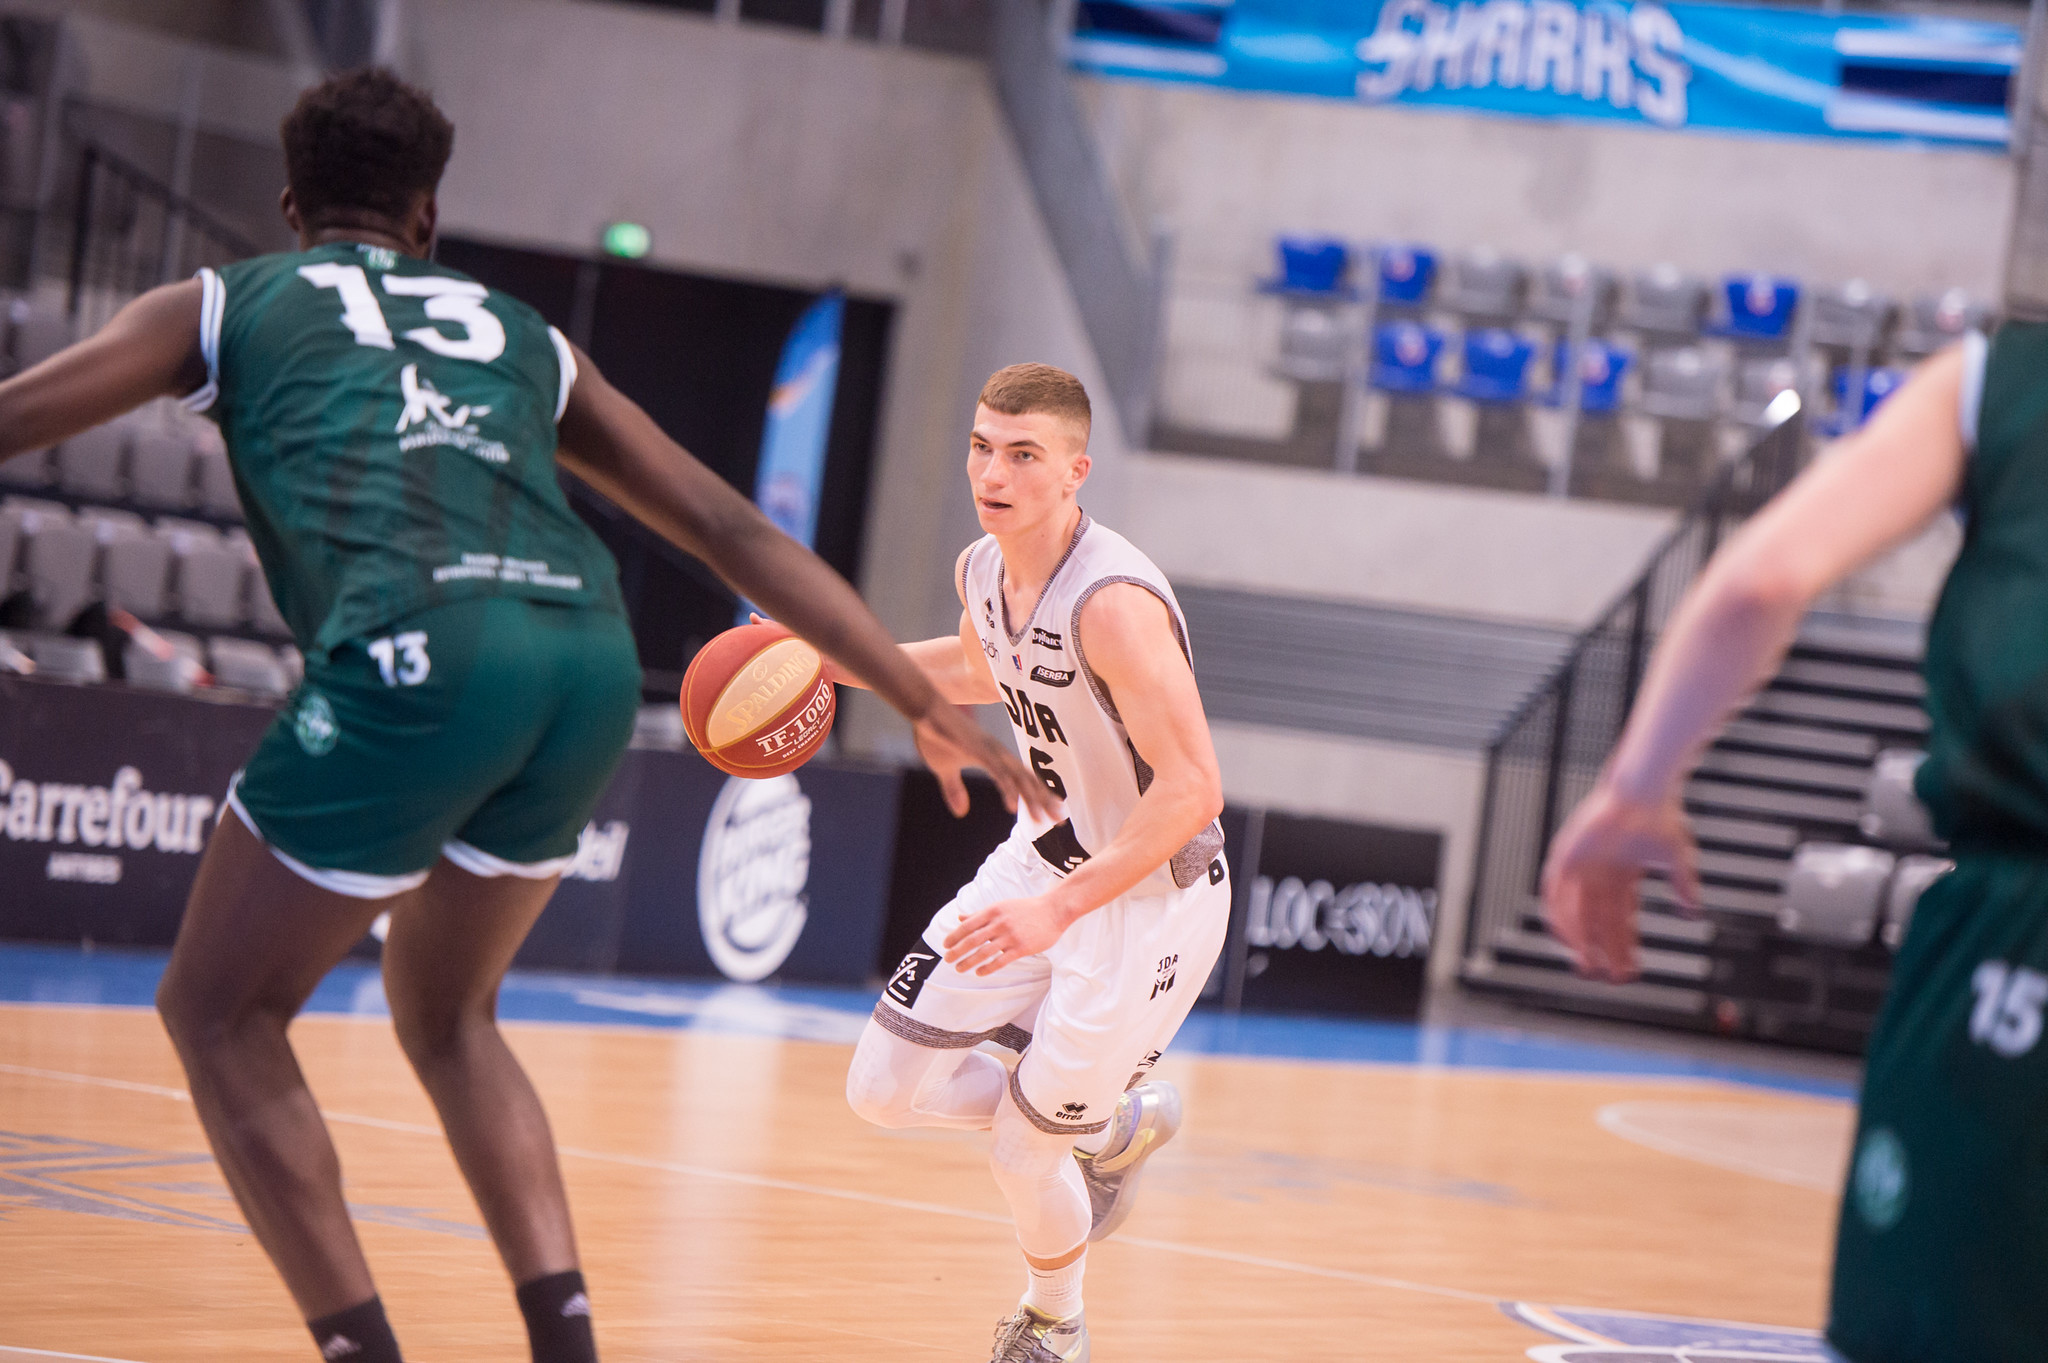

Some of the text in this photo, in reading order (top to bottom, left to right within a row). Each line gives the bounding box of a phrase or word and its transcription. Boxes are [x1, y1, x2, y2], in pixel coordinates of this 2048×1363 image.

[1355, 0, 1690, 128] SHARKS
[297, 262, 506, 363] 13
[367, 630, 431, 688] 13
[725, 648, 813, 733] SPALDING
[1036, 666, 1070, 681] ISERBA
[757, 683, 830, 752] TF-1000
[793, 717, 821, 745] LEGACY
[1000, 681, 1069, 747] JDA
[1029, 745, 1068, 802] 6
[1157, 953, 1179, 973] JDA
[1968, 960, 2048, 1058] 15
